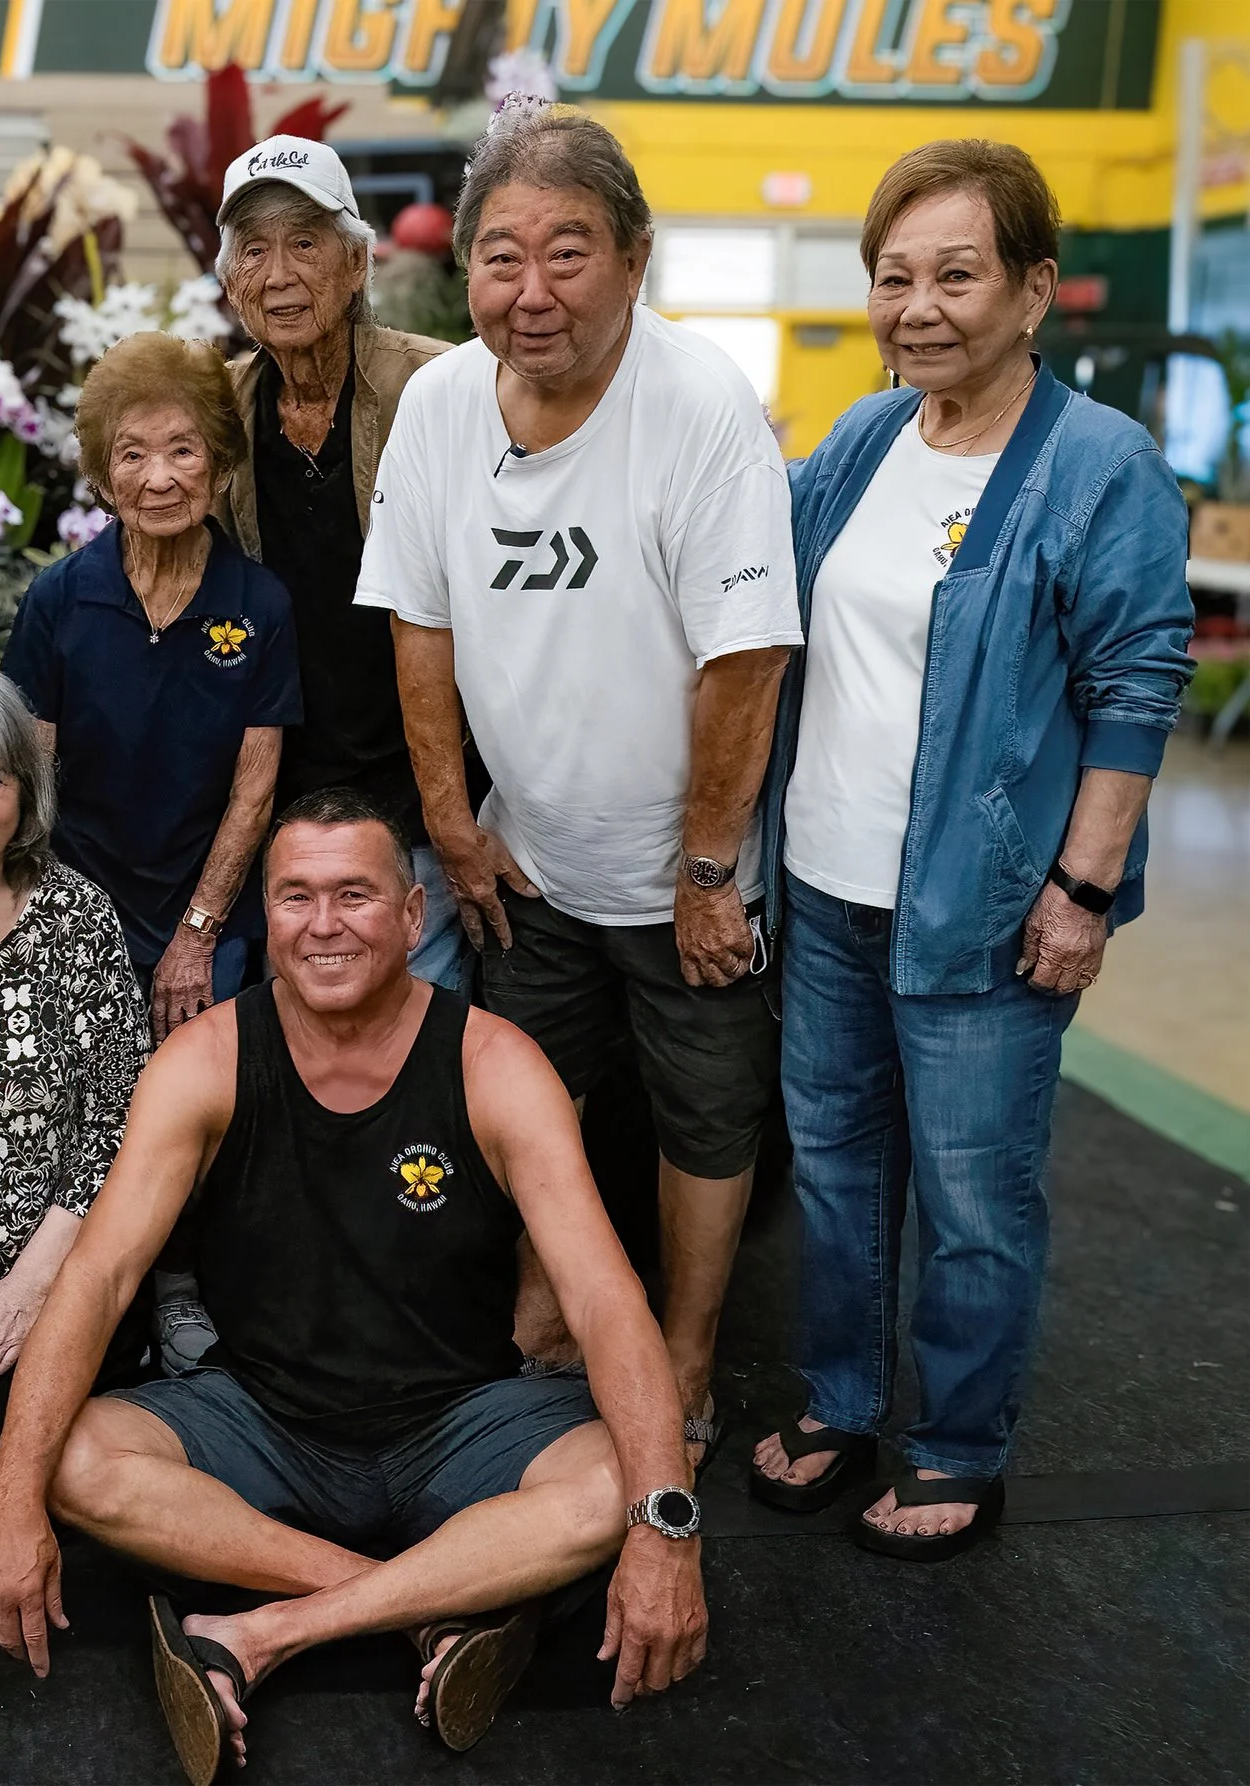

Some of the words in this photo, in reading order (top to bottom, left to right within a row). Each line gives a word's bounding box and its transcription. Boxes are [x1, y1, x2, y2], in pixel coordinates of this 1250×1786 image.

[635, 0, 1073, 101] MULES
[940, 511, 962, 528] AIEA
[389, 1153, 406, 1174] AIEA
[437, 1152, 455, 1176] CLUB
[420, 1194, 448, 1213] HAWAII
